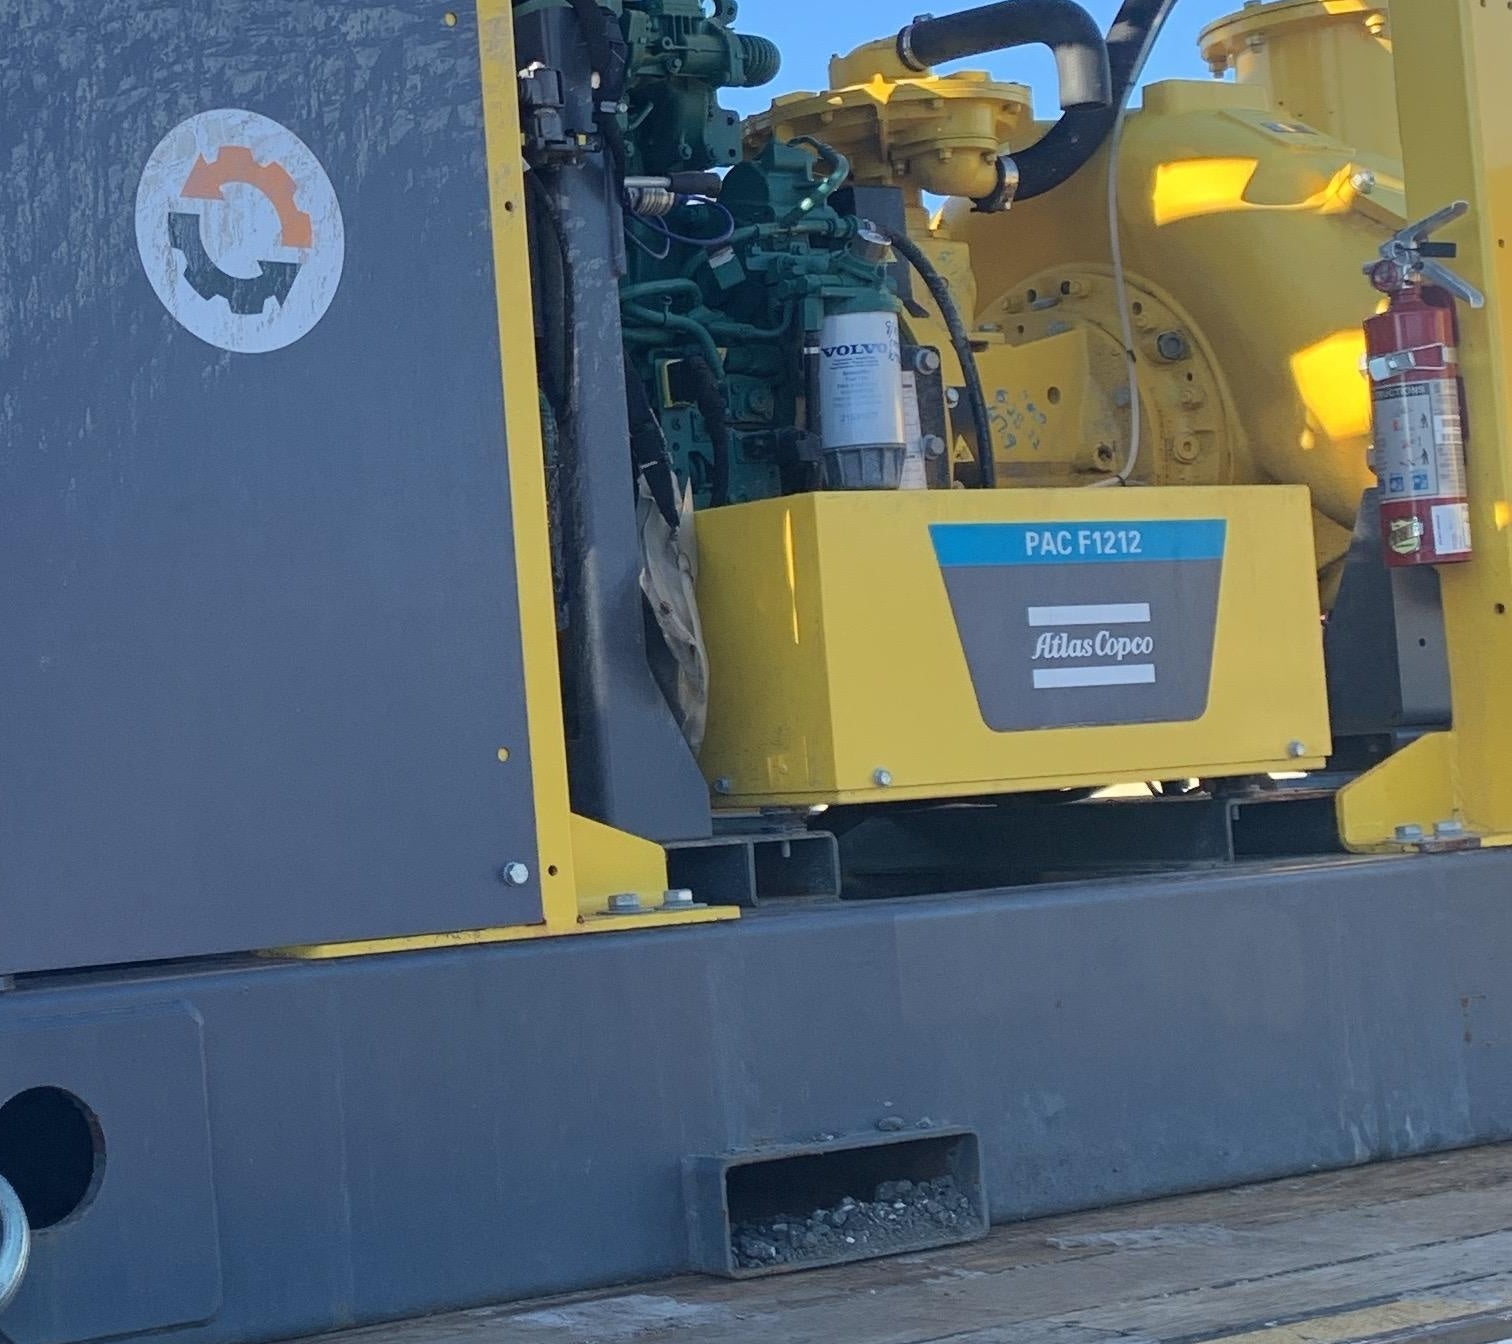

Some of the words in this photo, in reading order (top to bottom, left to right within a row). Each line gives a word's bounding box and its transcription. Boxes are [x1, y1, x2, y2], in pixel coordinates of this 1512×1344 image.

[820, 342, 888, 358] VOLVO
[1025, 531, 1072, 556] PAC
[1078, 530, 1143, 555] F1212
[1031, 631, 1094, 660] Atlas
[1094, 630, 1154, 661] Copco
